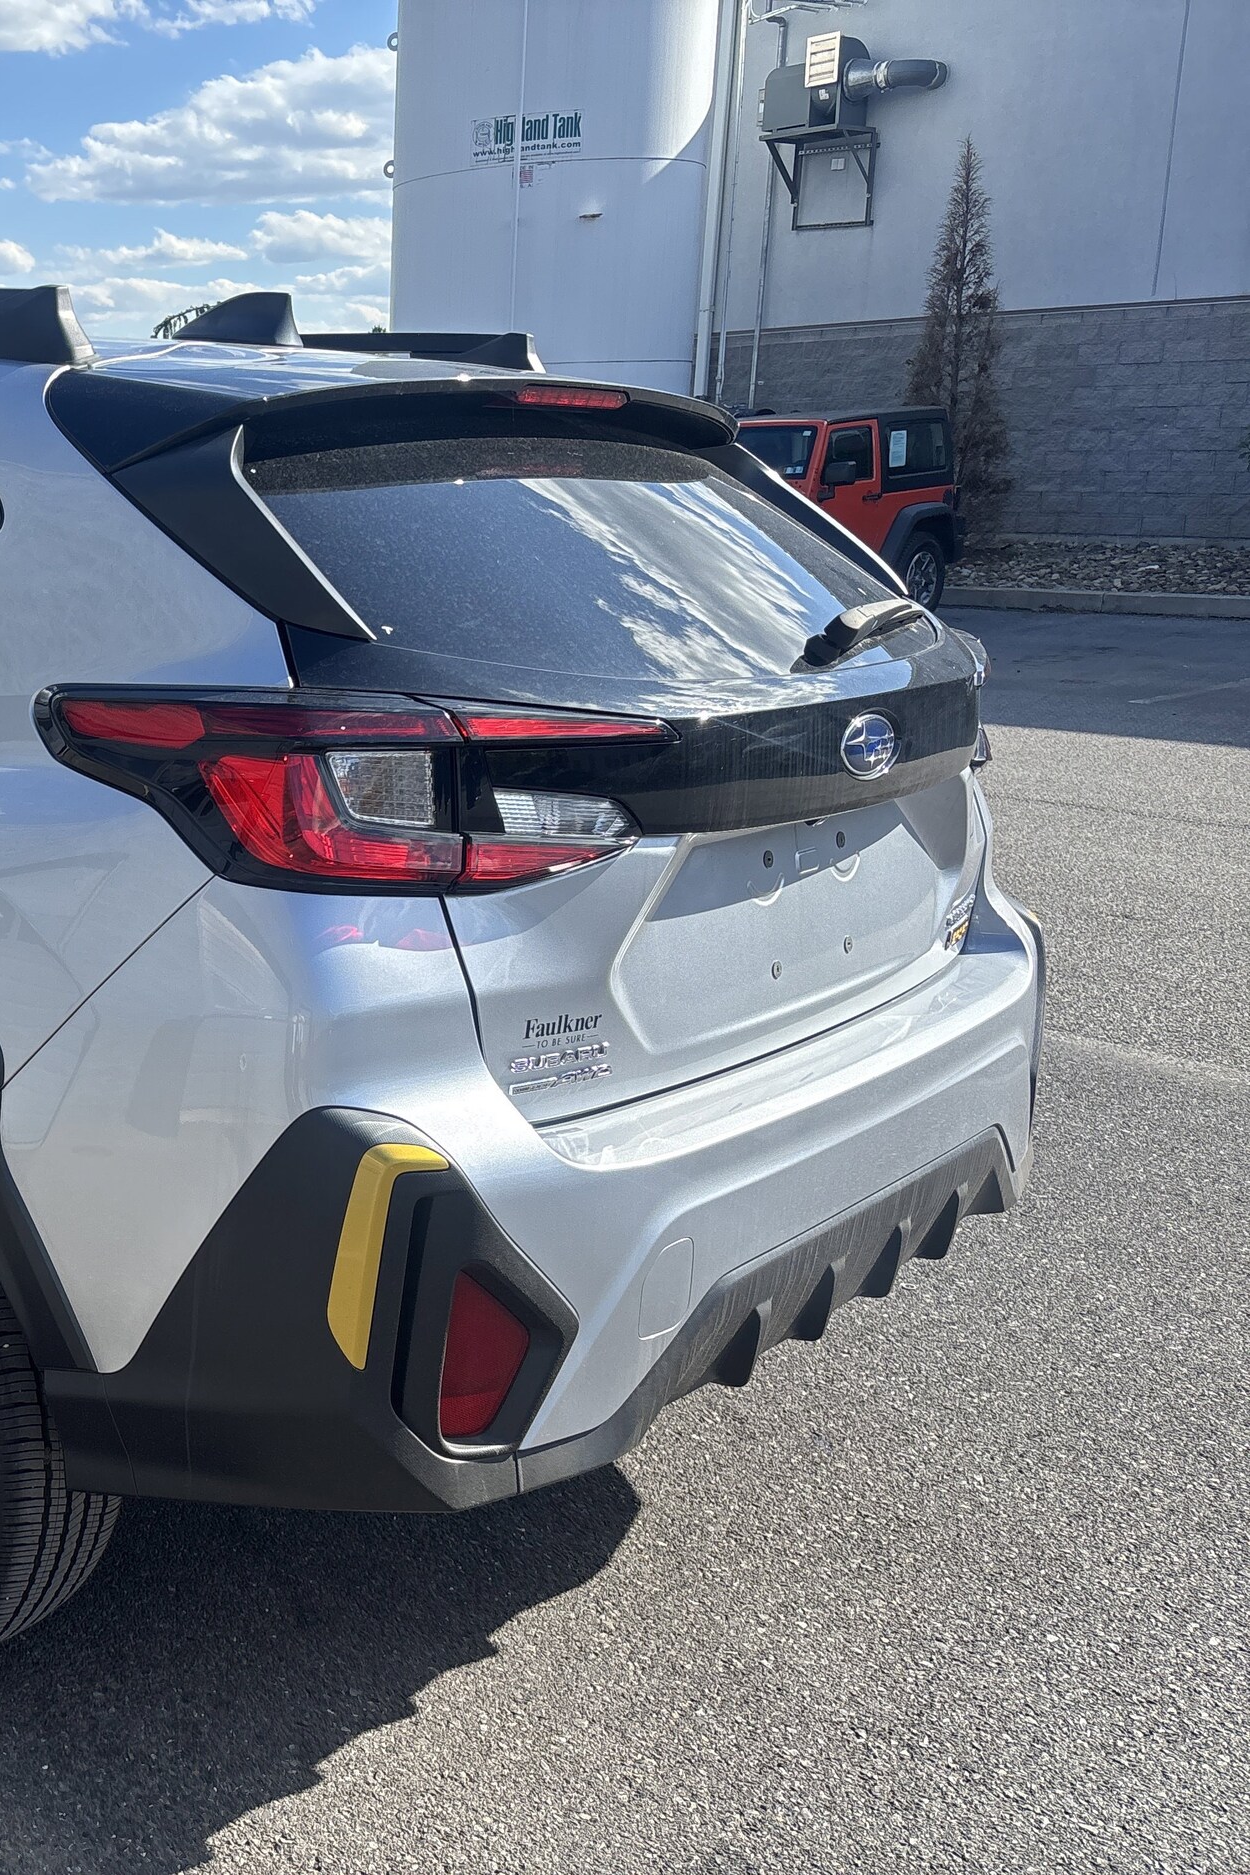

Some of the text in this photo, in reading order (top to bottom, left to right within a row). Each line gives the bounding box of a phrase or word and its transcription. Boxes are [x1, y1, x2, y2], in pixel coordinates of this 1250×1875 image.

[494, 114, 549, 146] Higland
[552, 112, 582, 139] Tank
[473, 141, 581, 157] www.highandtank.com
[523, 1014, 603, 1040] Faulkner
[537, 1034, 586, 1049] TO BE SURE
[510, 1041, 610, 1074] SUBARU
